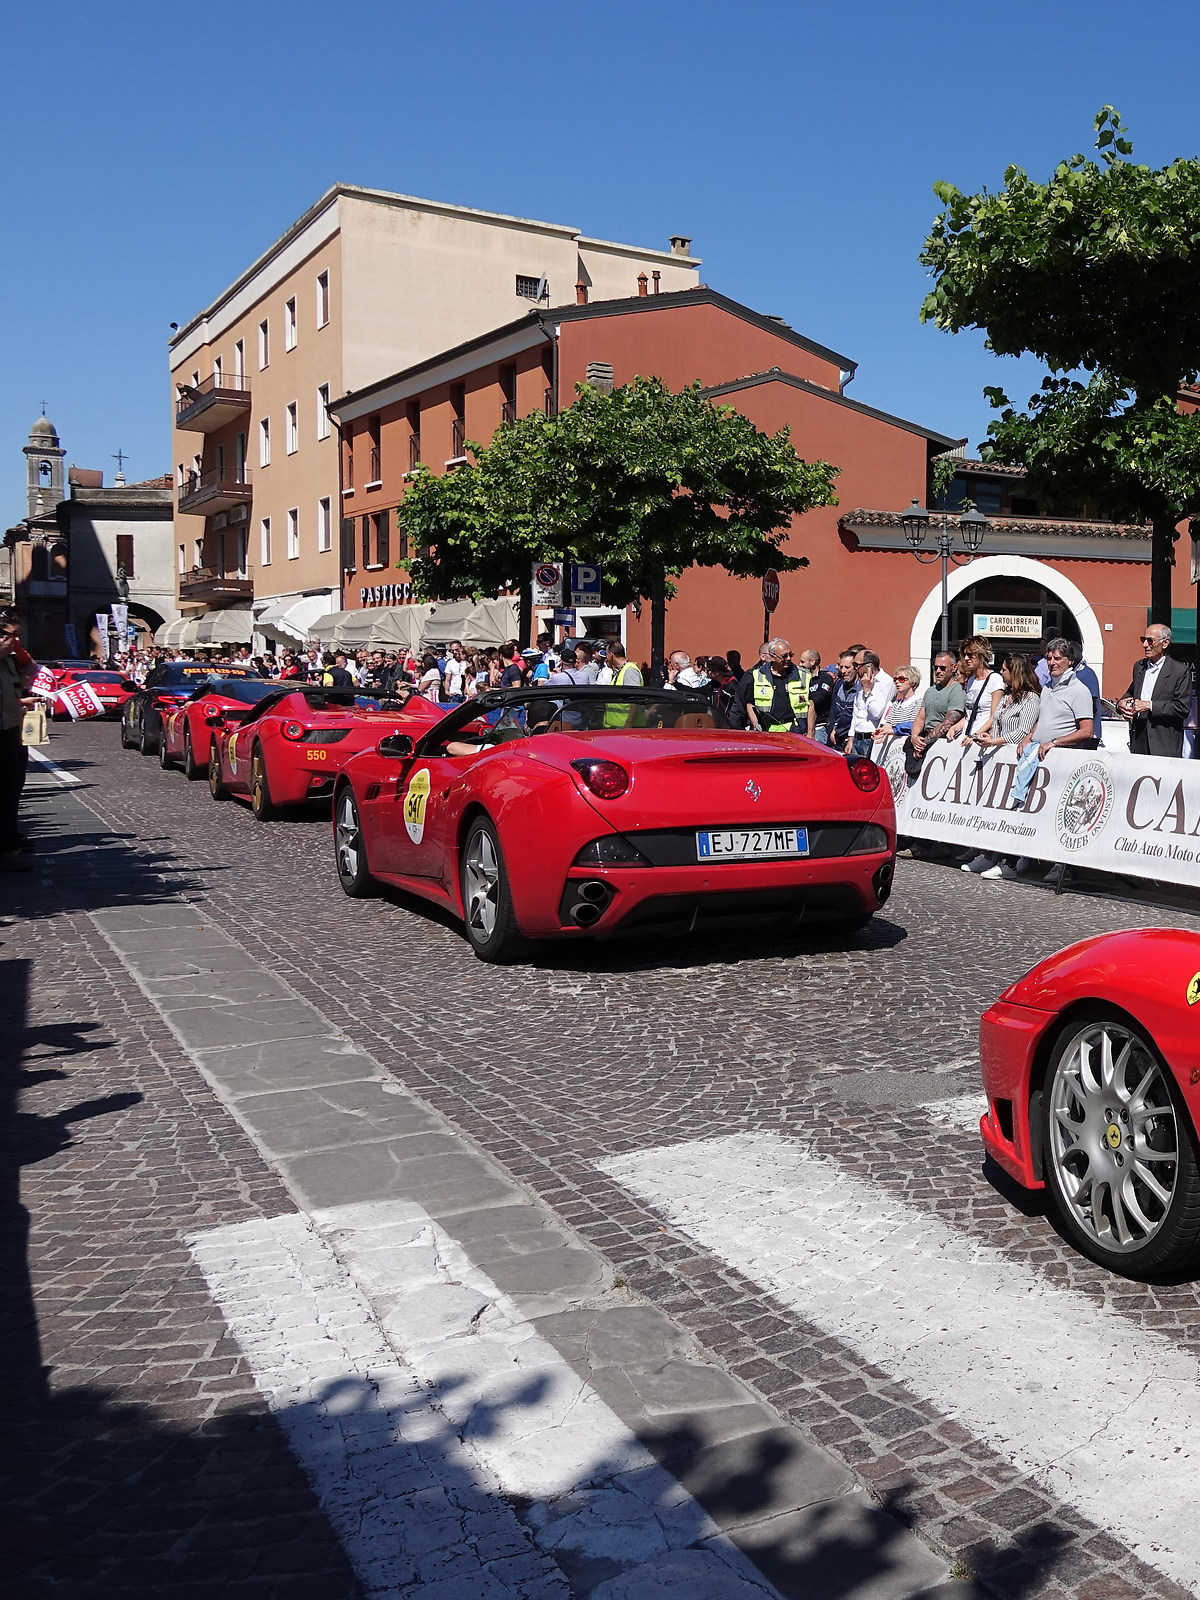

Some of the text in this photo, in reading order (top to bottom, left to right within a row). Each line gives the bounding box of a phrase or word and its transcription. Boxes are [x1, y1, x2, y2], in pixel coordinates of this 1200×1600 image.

[577, 566, 597, 590] P
[764, 581, 779, 599] STOP
[989, 616, 1039, 625] CARTOLIBRERIA
[989, 624, 1030, 633] E GIOCATTOLI
[67, 690, 87, 716] MIGLIA
[77, 689, 96, 711] 1000
[306, 750, 327, 760] 550
[408, 793, 424, 818] 547
[910, 807, 1037, 837] Club Auto Moto d'Epoca Bresciano
[1060, 832, 1089, 850] CAMEB
[1114, 836, 1138, 852] Club
[1138, 840, 1163, 857] Auto
[1164, 844, 1194, 862] Moto
